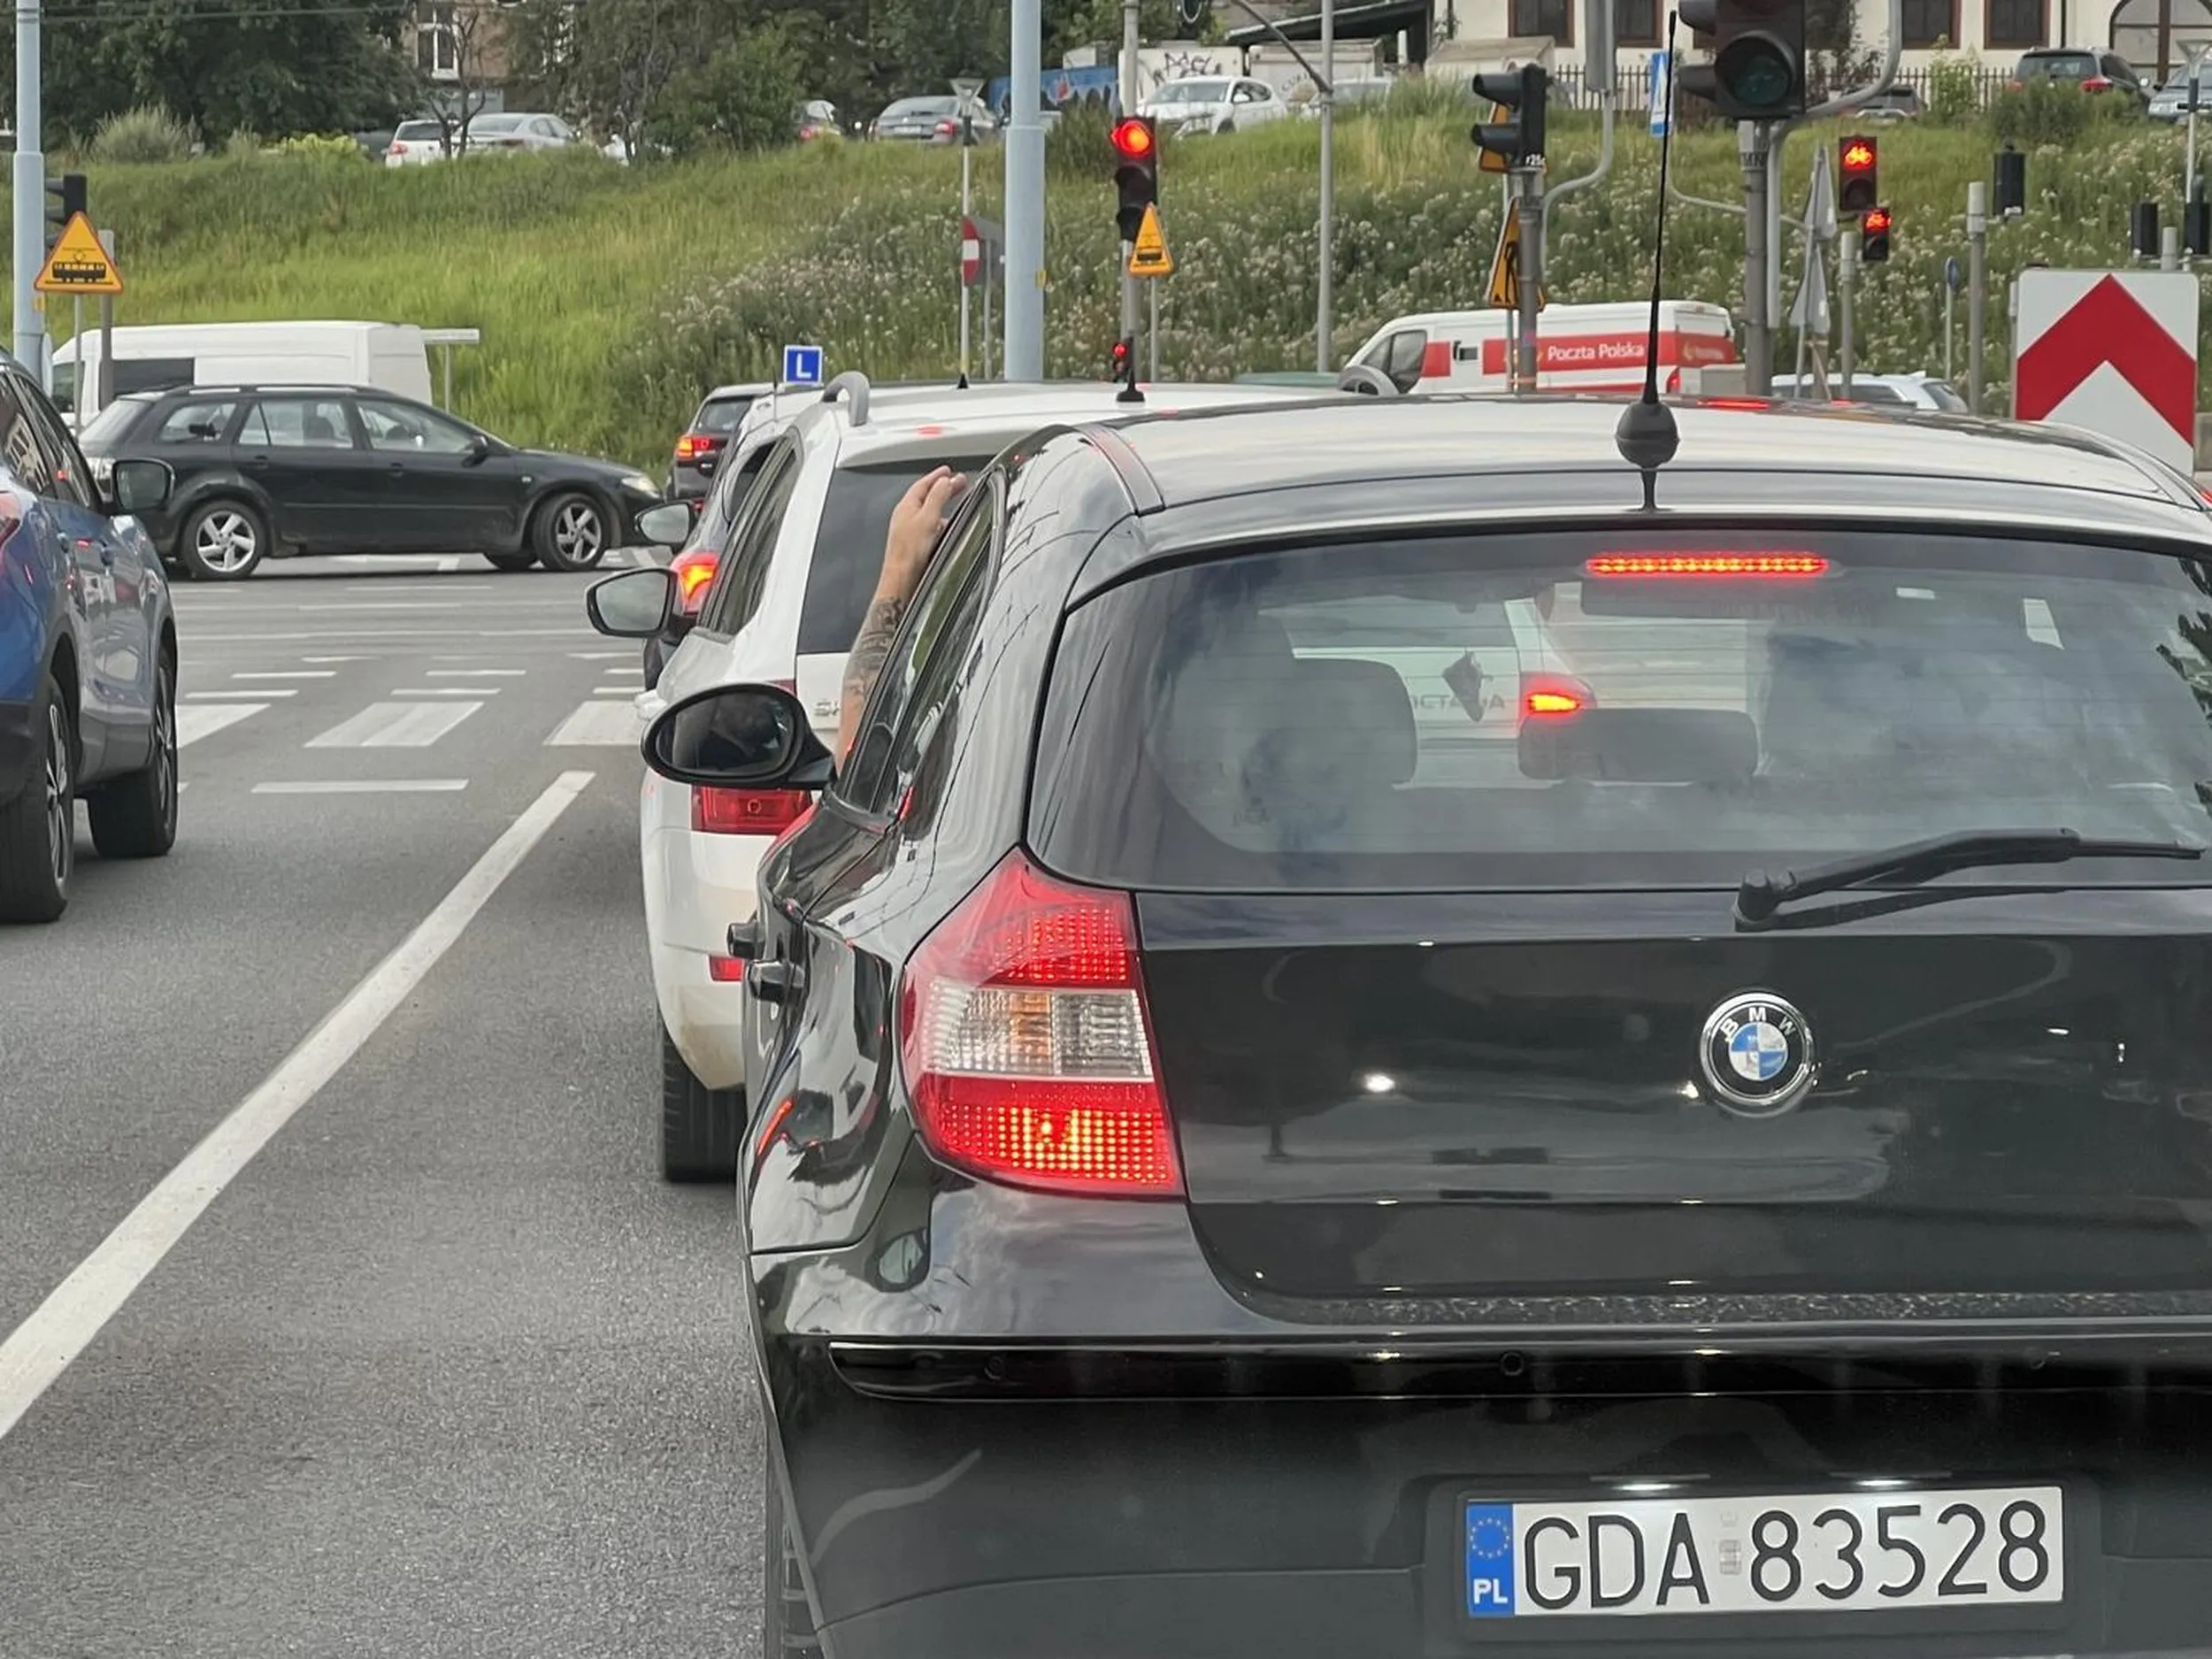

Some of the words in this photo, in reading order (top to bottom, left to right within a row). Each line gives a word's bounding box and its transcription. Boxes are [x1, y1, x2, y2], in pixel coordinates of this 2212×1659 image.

[1548, 344, 1595, 361] Poczta
[1599, 341, 1646, 358] Polska
[796, 353, 811, 378] L
[1720, 1007, 1796, 1039] BMW
[1523, 1512, 1710, 1609] GDA
[1749, 1500, 2049, 1601] 83528
[1473, 1579, 1508, 1604] PL
